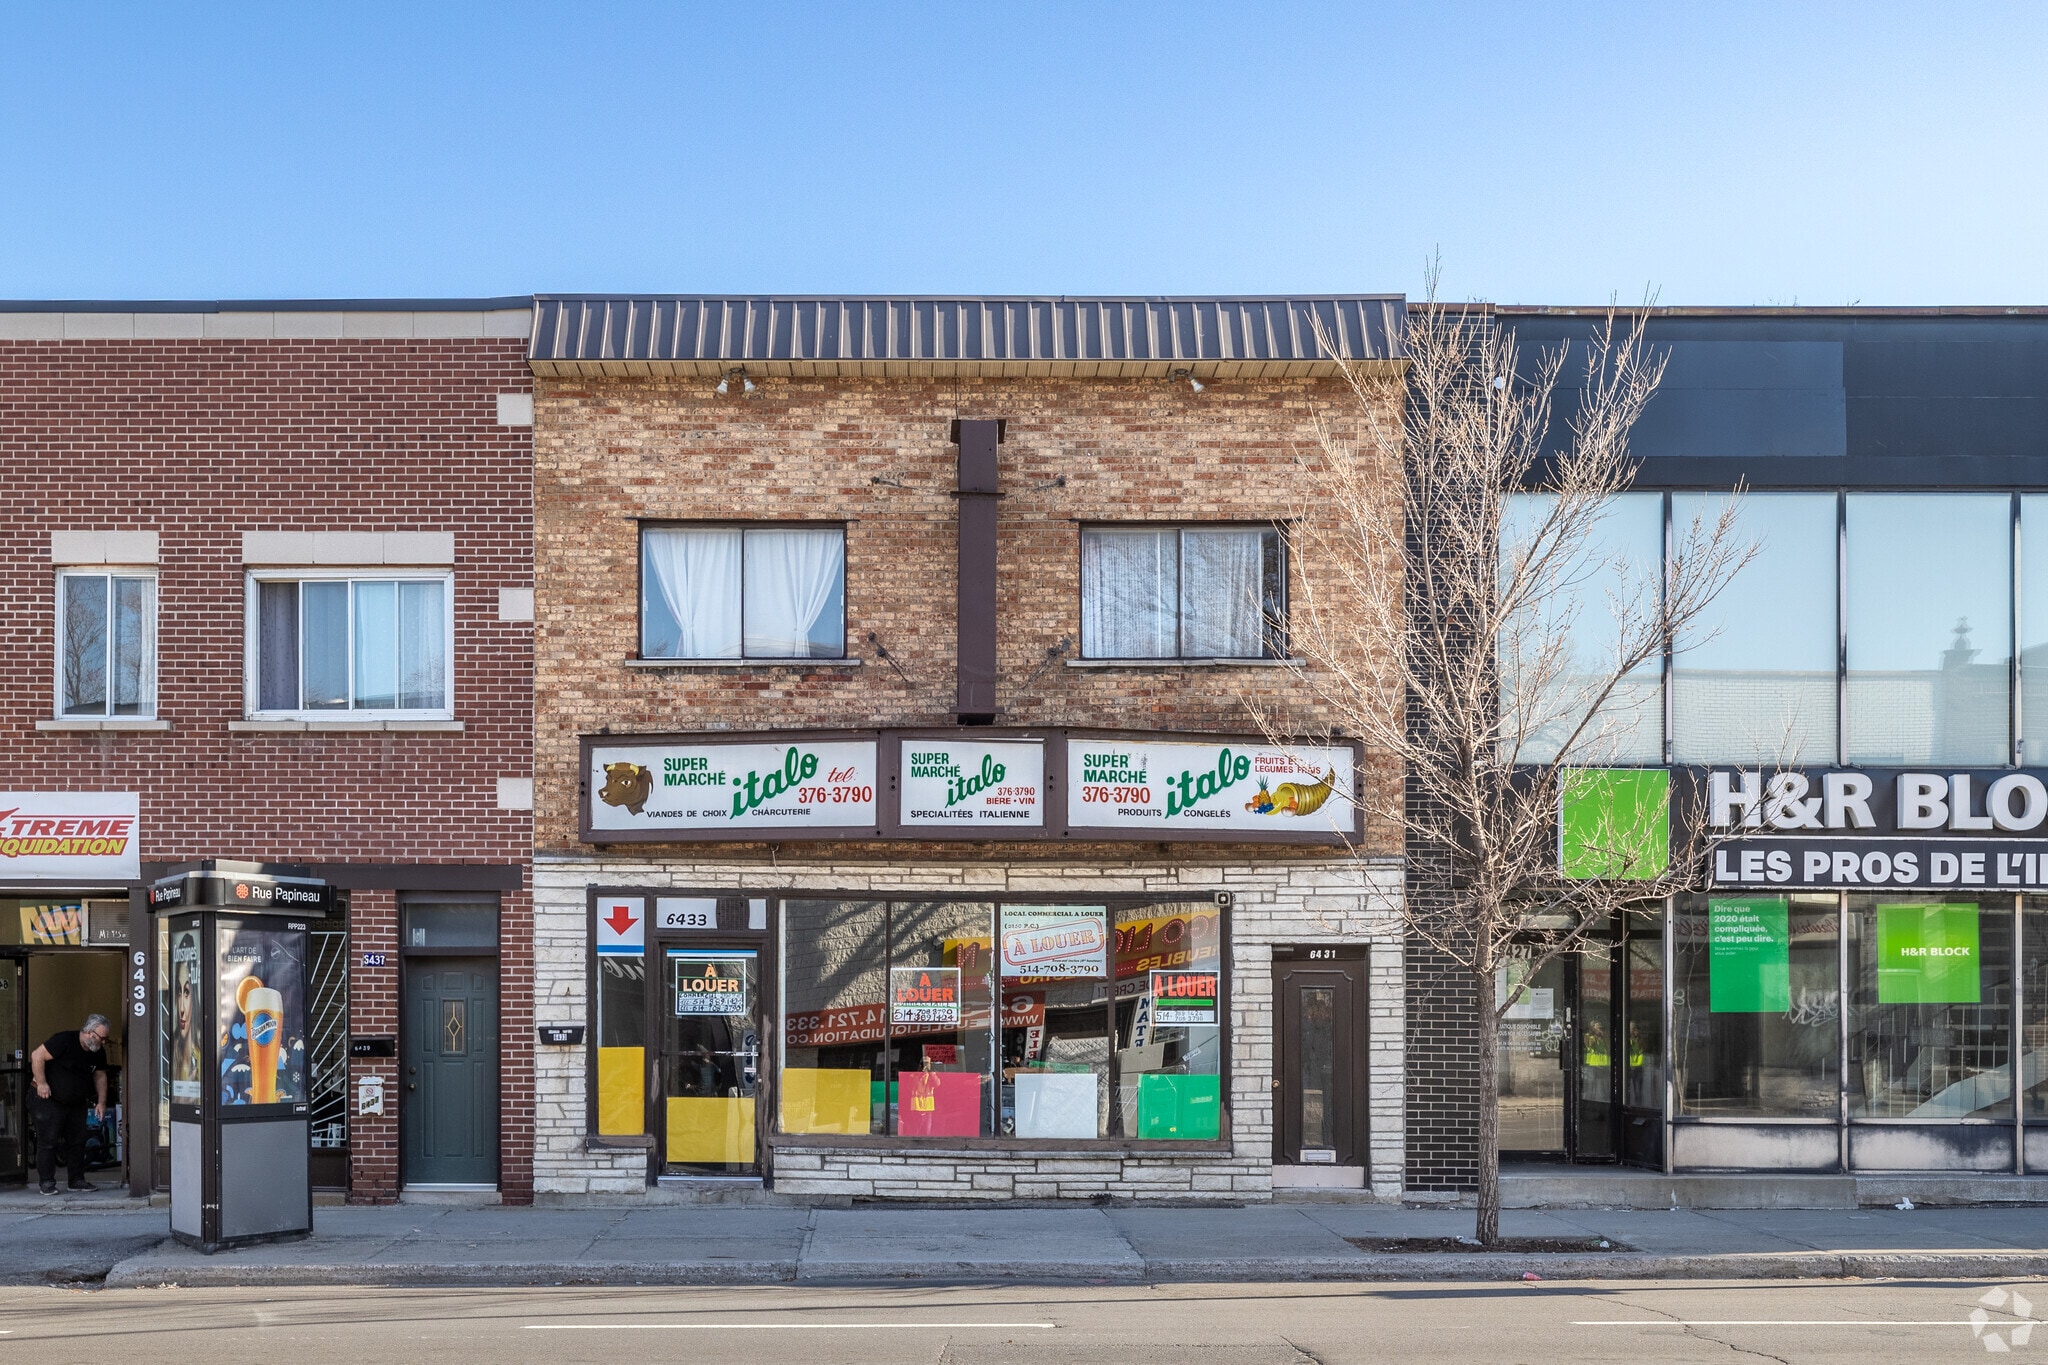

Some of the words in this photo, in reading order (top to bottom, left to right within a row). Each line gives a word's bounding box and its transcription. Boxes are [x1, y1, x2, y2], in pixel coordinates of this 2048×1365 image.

[663, 757, 708, 772] SUPER
[911, 752, 950, 765] SUPER
[1083, 753, 1130, 768] SUPER
[1254, 756, 1285, 765] FRUITS
[911, 763, 961, 778] MARCHÉ
[1083, 768, 1147, 784] MARCHÉ
[1255, 765, 1294, 774] LEGUMES
[663, 770, 726, 787] MARCHÉ
[729, 746, 820, 820] italo
[945, 753, 1007, 808] italo
[1164, 747, 1251, 819] italo
[798, 786, 873, 804] 376-3790
[997, 786, 1035, 796] 376-3790
[1082, 786, 1151, 804] 376-3790
[1018, 797, 1036, 805] VIN
[1709, 771, 1877, 830] H&R
[646, 810, 683, 818] VIANDES
[686, 810, 698, 818] DE
[702, 809, 727, 818] CHOIX
[751, 807, 811, 817] CHARCUTERIE
[910, 808, 973, 818] SPECIALITÉES
[979, 810, 1030, 818] ITALIENNE
[1118, 808, 1162, 817] PRODUITS
[1183, 808, 1231, 818] CONGELÉS
[1715, 850, 1793, 882] LES
[1803, 850, 1920, 883] PROS
[1930, 851, 1986, 884] DE
[1996, 852, 2048, 885] L'I
[155, 890, 163, 902] Rue
[163, 887, 181, 902] Papineau
[252, 886, 272, 899] Rue
[275, 887, 320, 903] Papineau
[1734, 906, 1751, 914] que
[665, 913, 708, 926] 6433
[1715, 915, 1738, 923] 2020
[1739, 914, 1760, 923] était
[1714, 924, 1768, 934] compliquée,
[1013, 938, 1027, 956] À
[1030, 929, 1096, 953] LOUER
[1714, 935, 1735, 943] c'est
[1736, 936, 1753, 944] peu
[1754, 934, 1774, 942] dire.
[248, 946, 257, 954] DE
[1310, 950, 1336, 959] 6431
[1901, 947, 1927, 957] H&R
[1930, 946, 1970, 957] BLOCK
[227, 955, 242, 963] BIEN
[243, 955, 262, 963] FAIRE
[704, 963, 717, 978] À
[1020, 963, 1099, 975] 514-708-3790
[133, 951, 146, 1017] 6439
[683, 979, 739, 992] LOUER
[1167, 975, 1216, 997] LOUER
[897, 987, 954, 1002] LOUER
